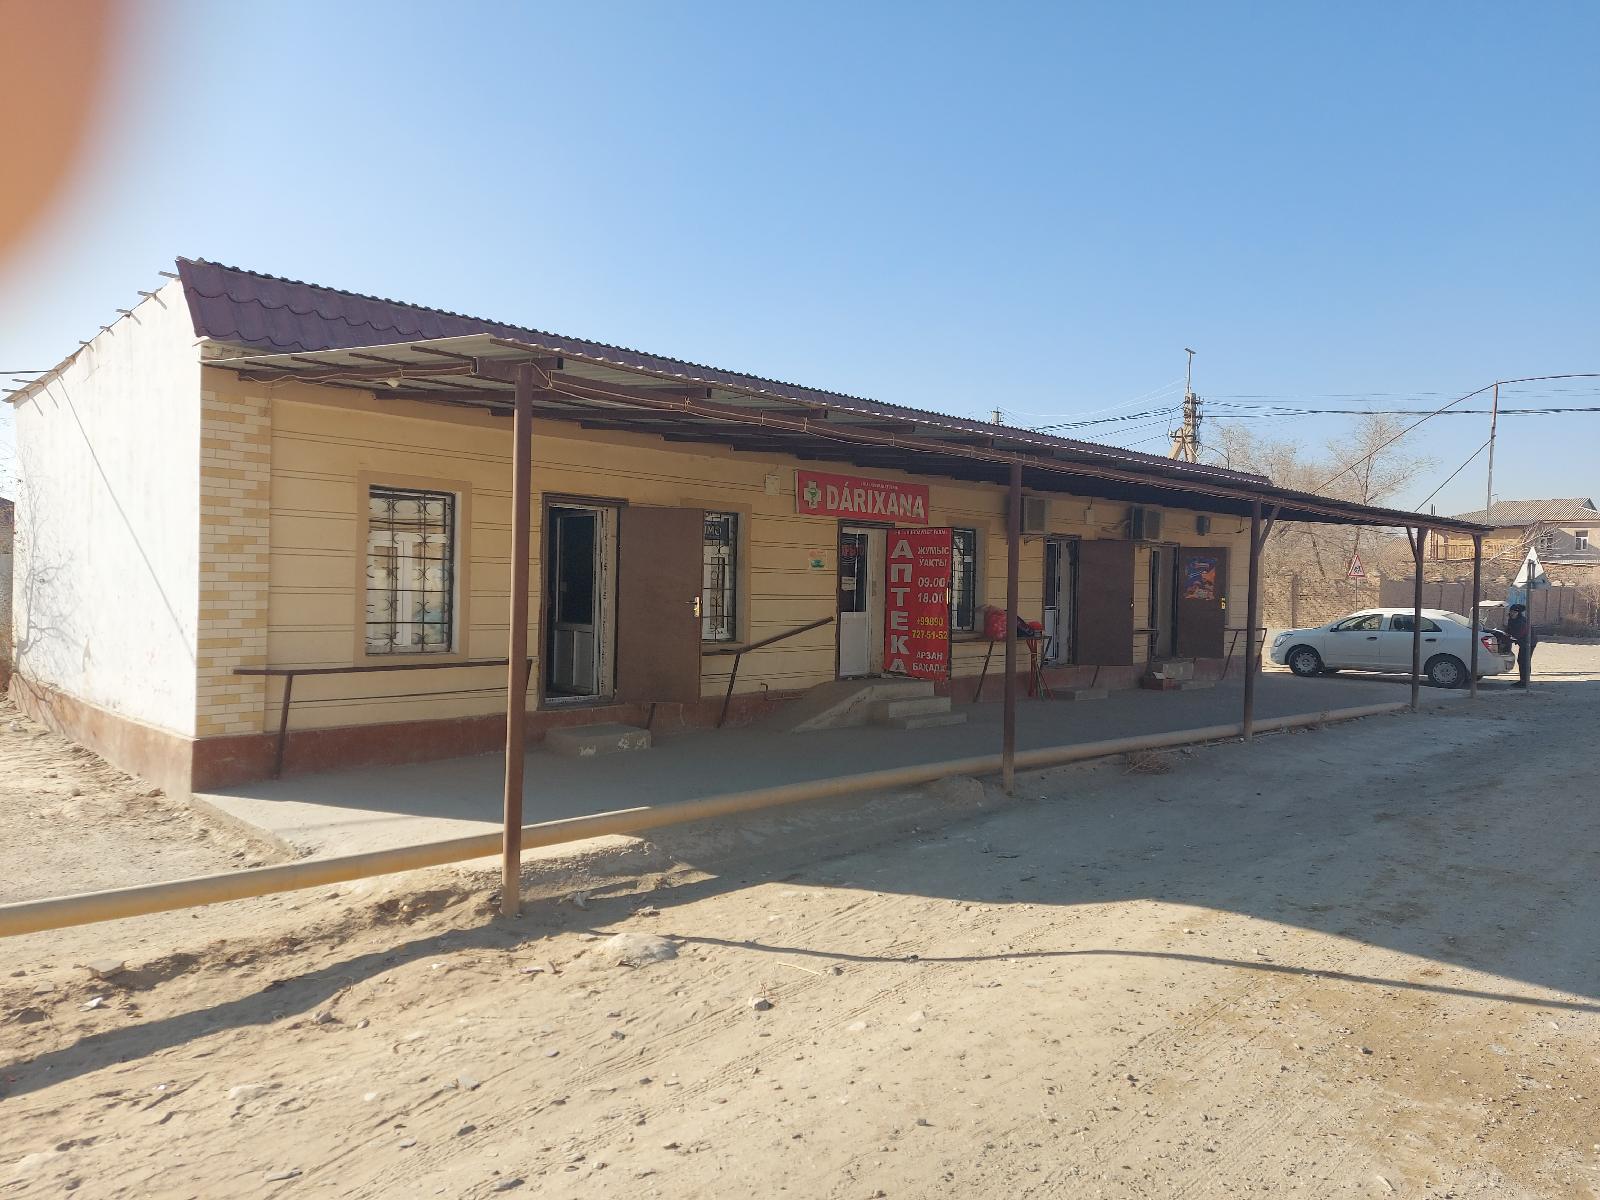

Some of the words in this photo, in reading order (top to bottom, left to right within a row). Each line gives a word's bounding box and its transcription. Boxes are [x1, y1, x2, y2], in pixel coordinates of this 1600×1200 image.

[826, 482, 925, 518] DÁRIXANA
[917, 546, 950, 555] ЖУМЫС
[918, 577, 946, 588] 09.00
[917, 592, 945, 604] 18.00
[890, 539, 914, 674] АПТЕКА
[916, 651, 943, 661] АРЗАН
